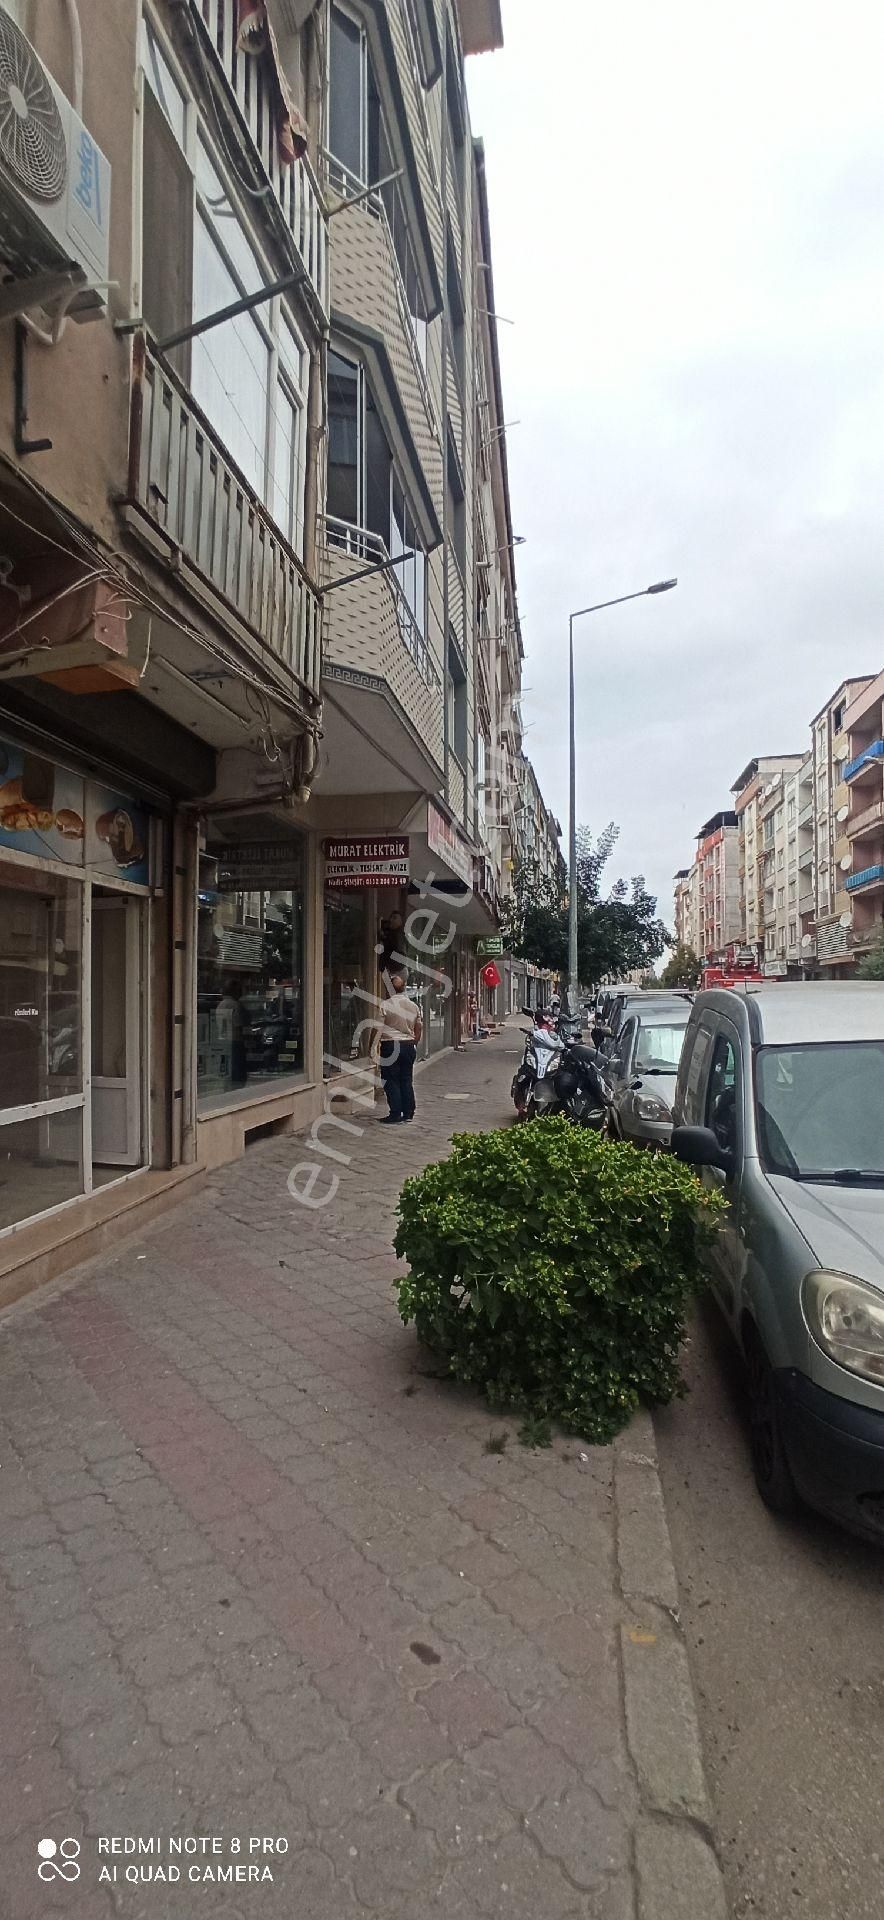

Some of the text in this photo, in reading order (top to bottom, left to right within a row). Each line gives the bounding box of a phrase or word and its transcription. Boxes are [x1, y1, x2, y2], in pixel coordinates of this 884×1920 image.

[75, 131, 93, 208] beko
[329, 841, 405, 857] MURAT ELEKTRİK
[389, 862, 407, 872] AVİZE
